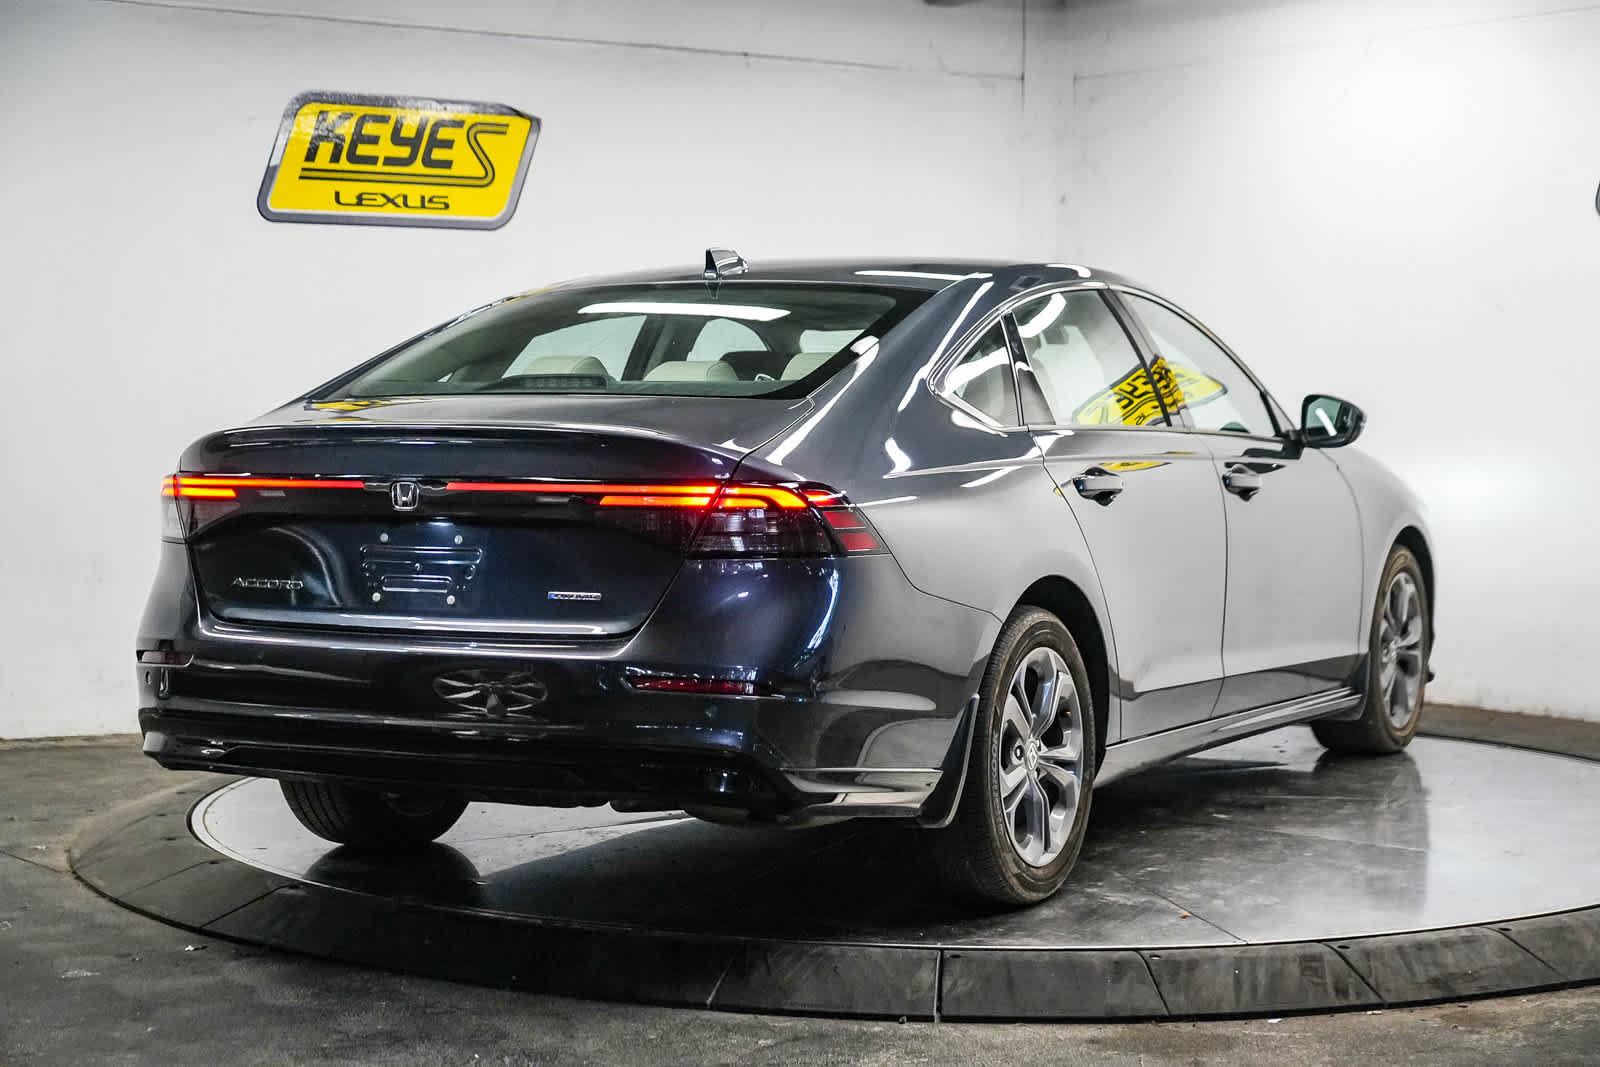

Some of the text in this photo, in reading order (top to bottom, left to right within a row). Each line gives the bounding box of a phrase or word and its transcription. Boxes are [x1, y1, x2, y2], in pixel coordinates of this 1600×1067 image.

[300, 110, 509, 187] KEYES
[334, 190, 450, 210] LEXUS
[232, 577, 304, 590] ACCORD
